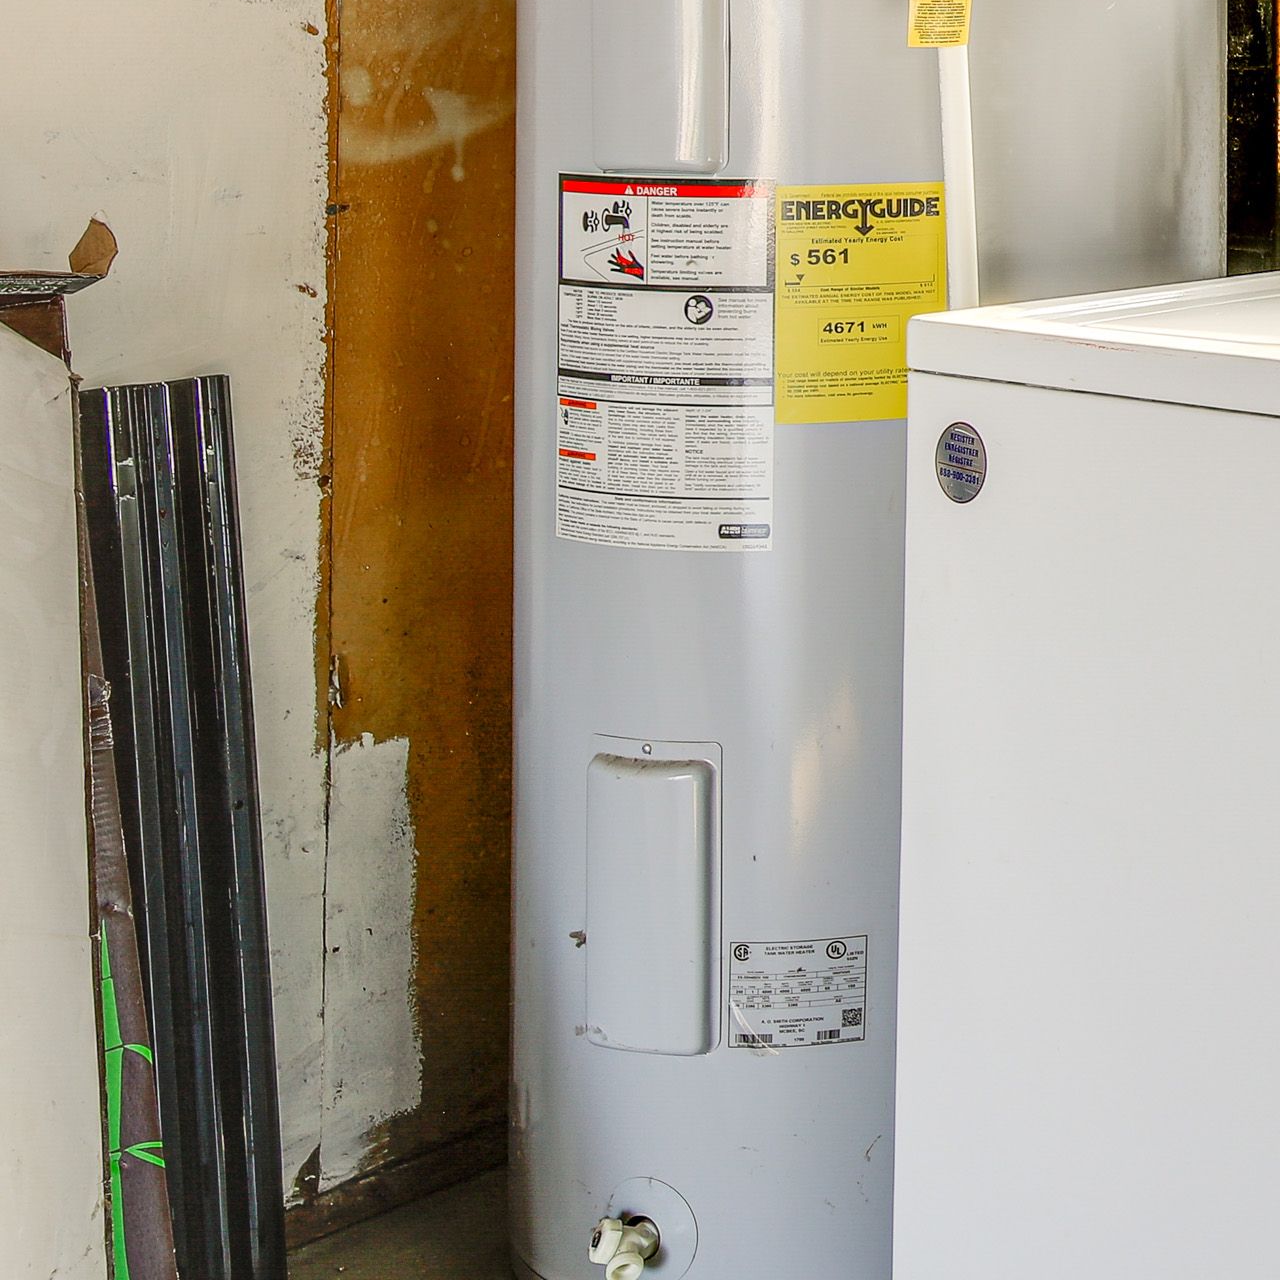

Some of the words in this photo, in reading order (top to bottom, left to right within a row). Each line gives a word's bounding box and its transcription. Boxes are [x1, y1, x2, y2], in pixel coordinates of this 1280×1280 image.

[636, 186, 678, 196] DANGER
[781, 197, 940, 221] ENERGYGUIDE
[618, 233, 636, 243] HOT
[811, 237, 842, 245] Estimated
[844, 236, 864, 245] Yearly
[866, 236, 888, 244] Energy
[890, 235, 904, 243] Cost
[790, 253, 800, 267] $
[807, 248, 849, 266] 561
[823, 321, 866, 334] 4671
[823, 371, 848, 379] depend
[611, 376, 649, 384] IMPORTANT
[653, 377, 700, 386] IMPORTANTE
[951, 433, 975, 445] REGISTER
